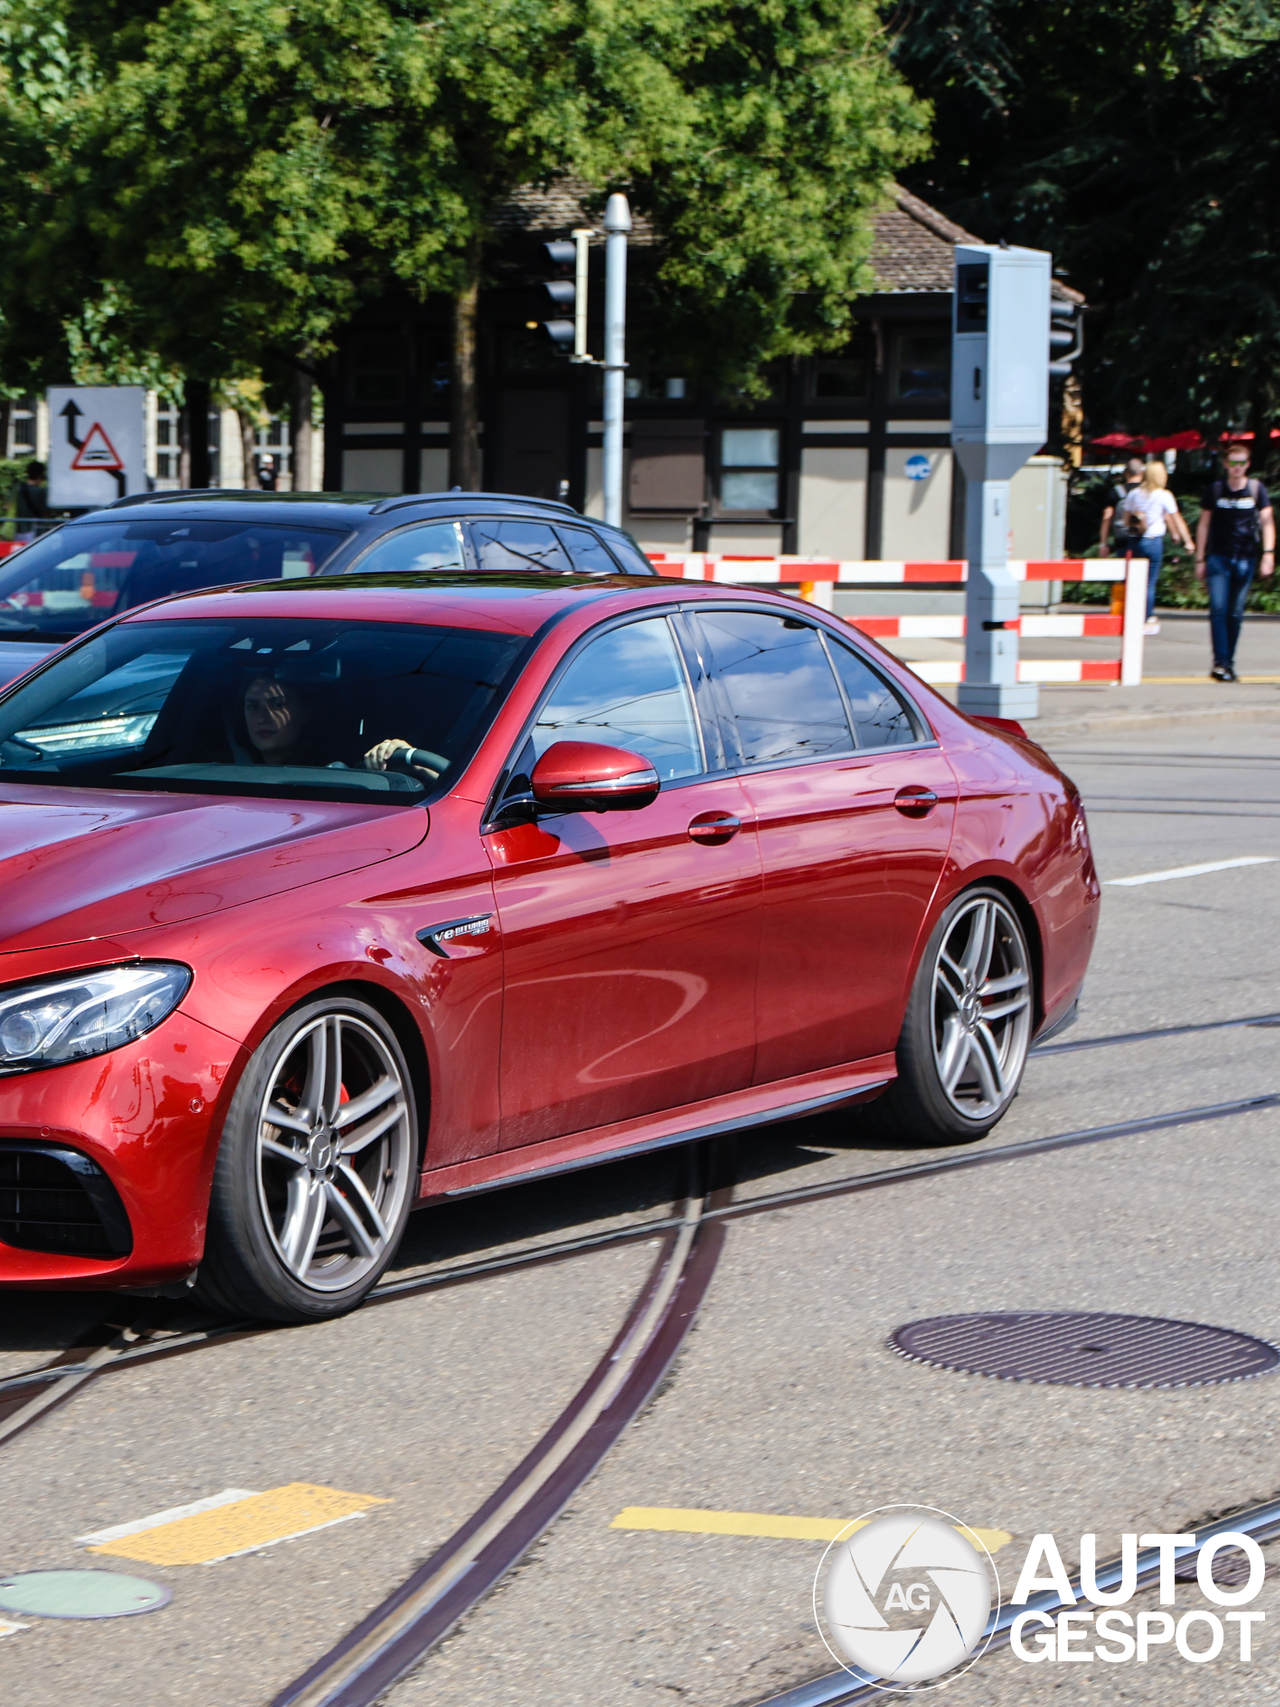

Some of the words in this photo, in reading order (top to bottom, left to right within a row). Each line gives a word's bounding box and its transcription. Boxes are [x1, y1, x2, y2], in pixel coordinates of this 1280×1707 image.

[903, 463, 932, 478] WC
[434, 930, 454, 941] V8
[455, 919, 489, 935] BITURBO
